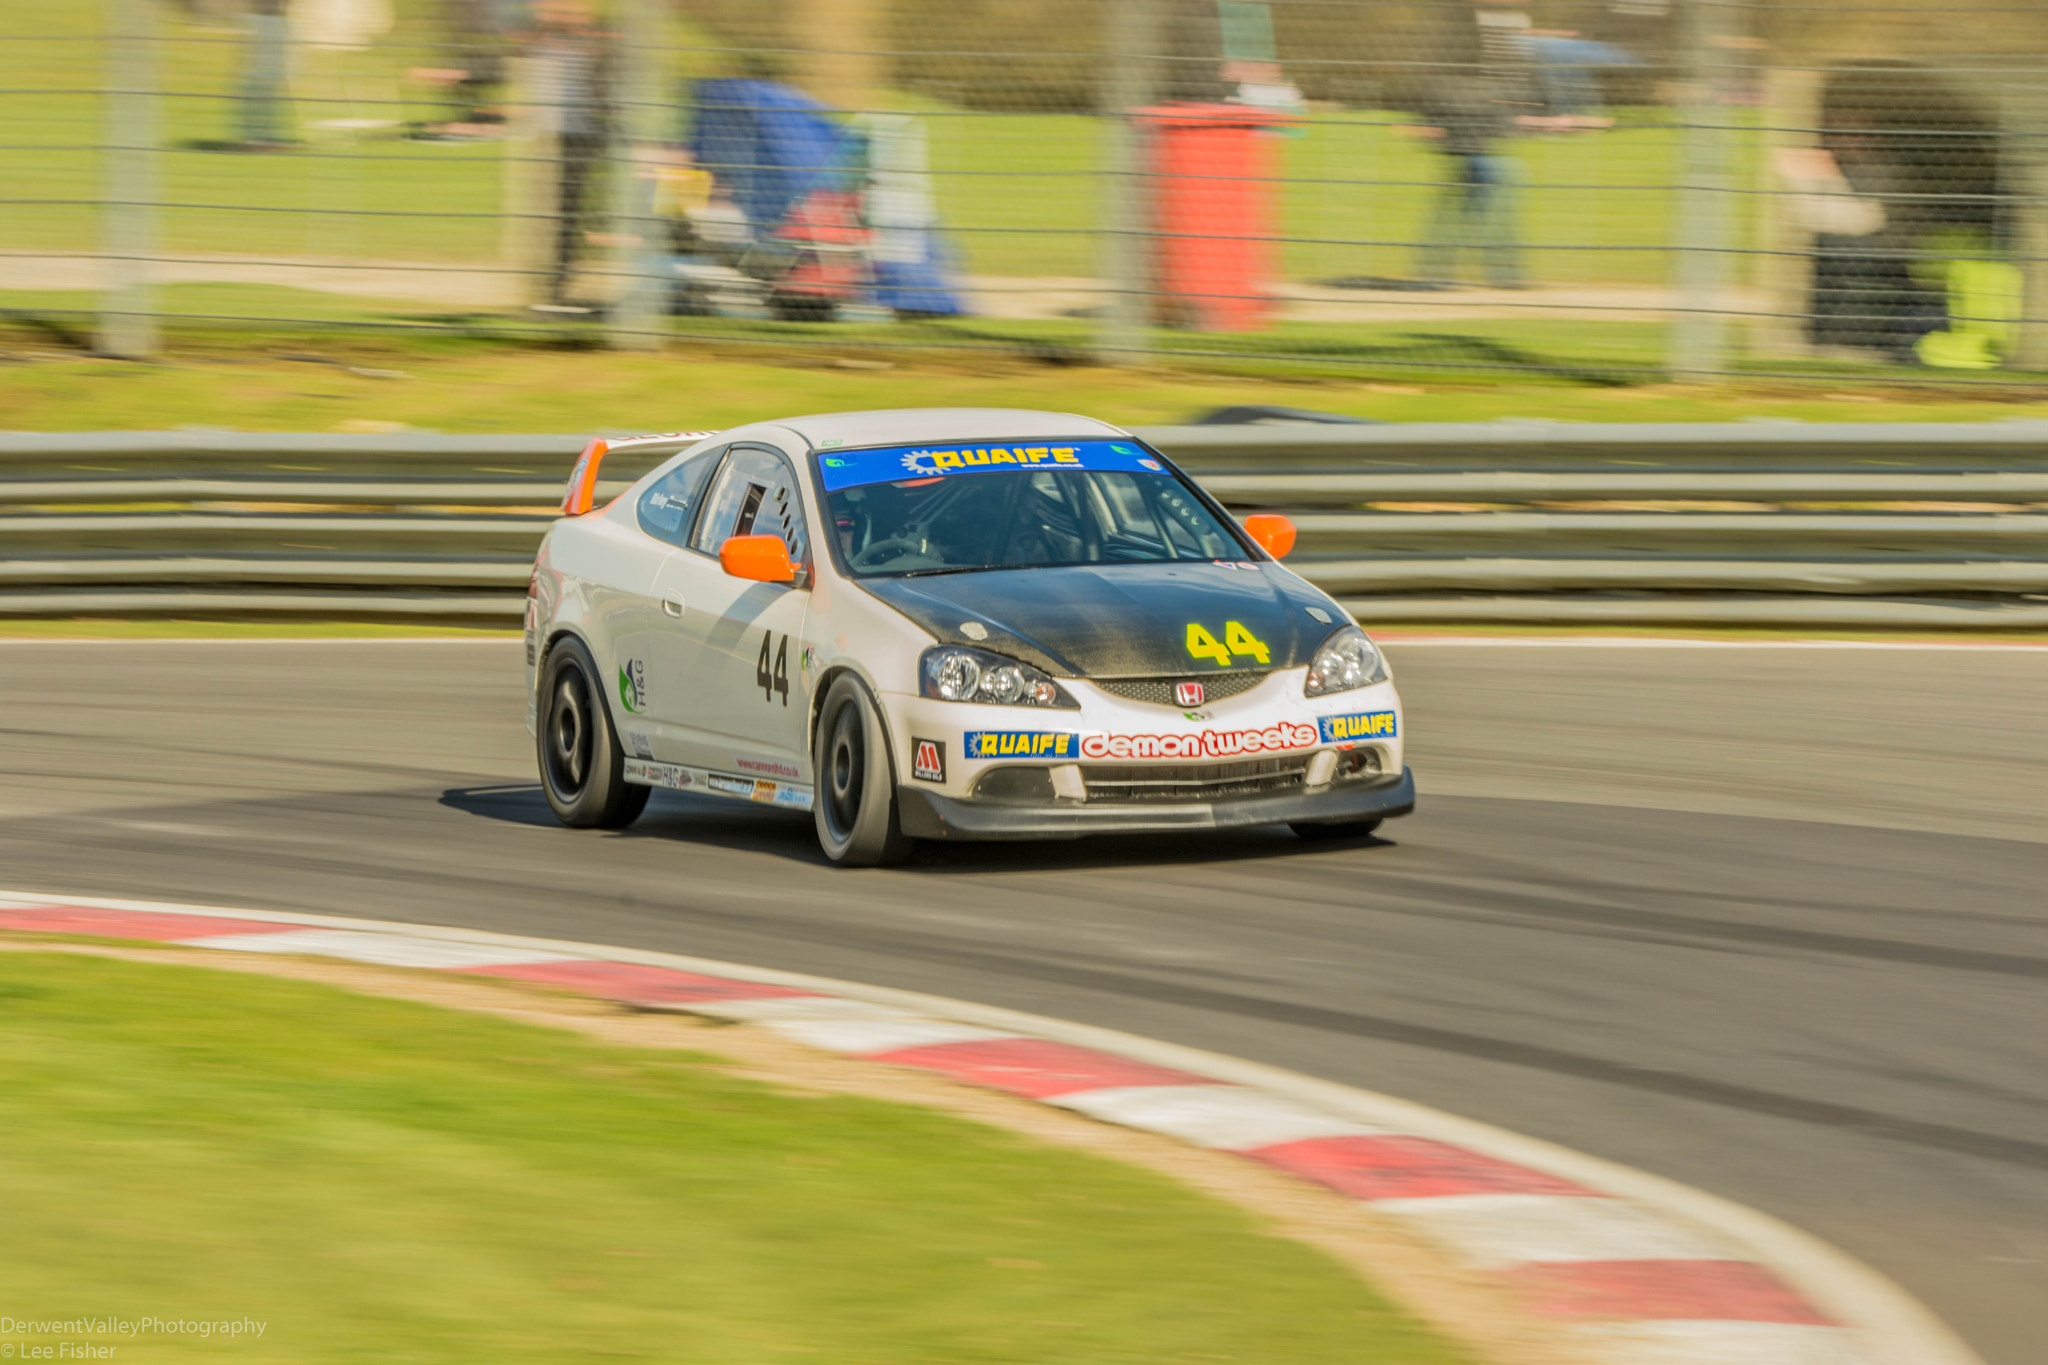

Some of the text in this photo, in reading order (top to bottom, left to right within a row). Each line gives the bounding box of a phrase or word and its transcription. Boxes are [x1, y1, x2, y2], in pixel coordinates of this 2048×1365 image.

[930, 447, 1079, 468] QUAIFE
[1186, 621, 1271, 666] 44
[635, 659, 646, 707] H&G
[757, 629, 789, 708] 44
[1333, 713, 1394, 738] QUAIFE
[980, 733, 1070, 756] QUAIFE
